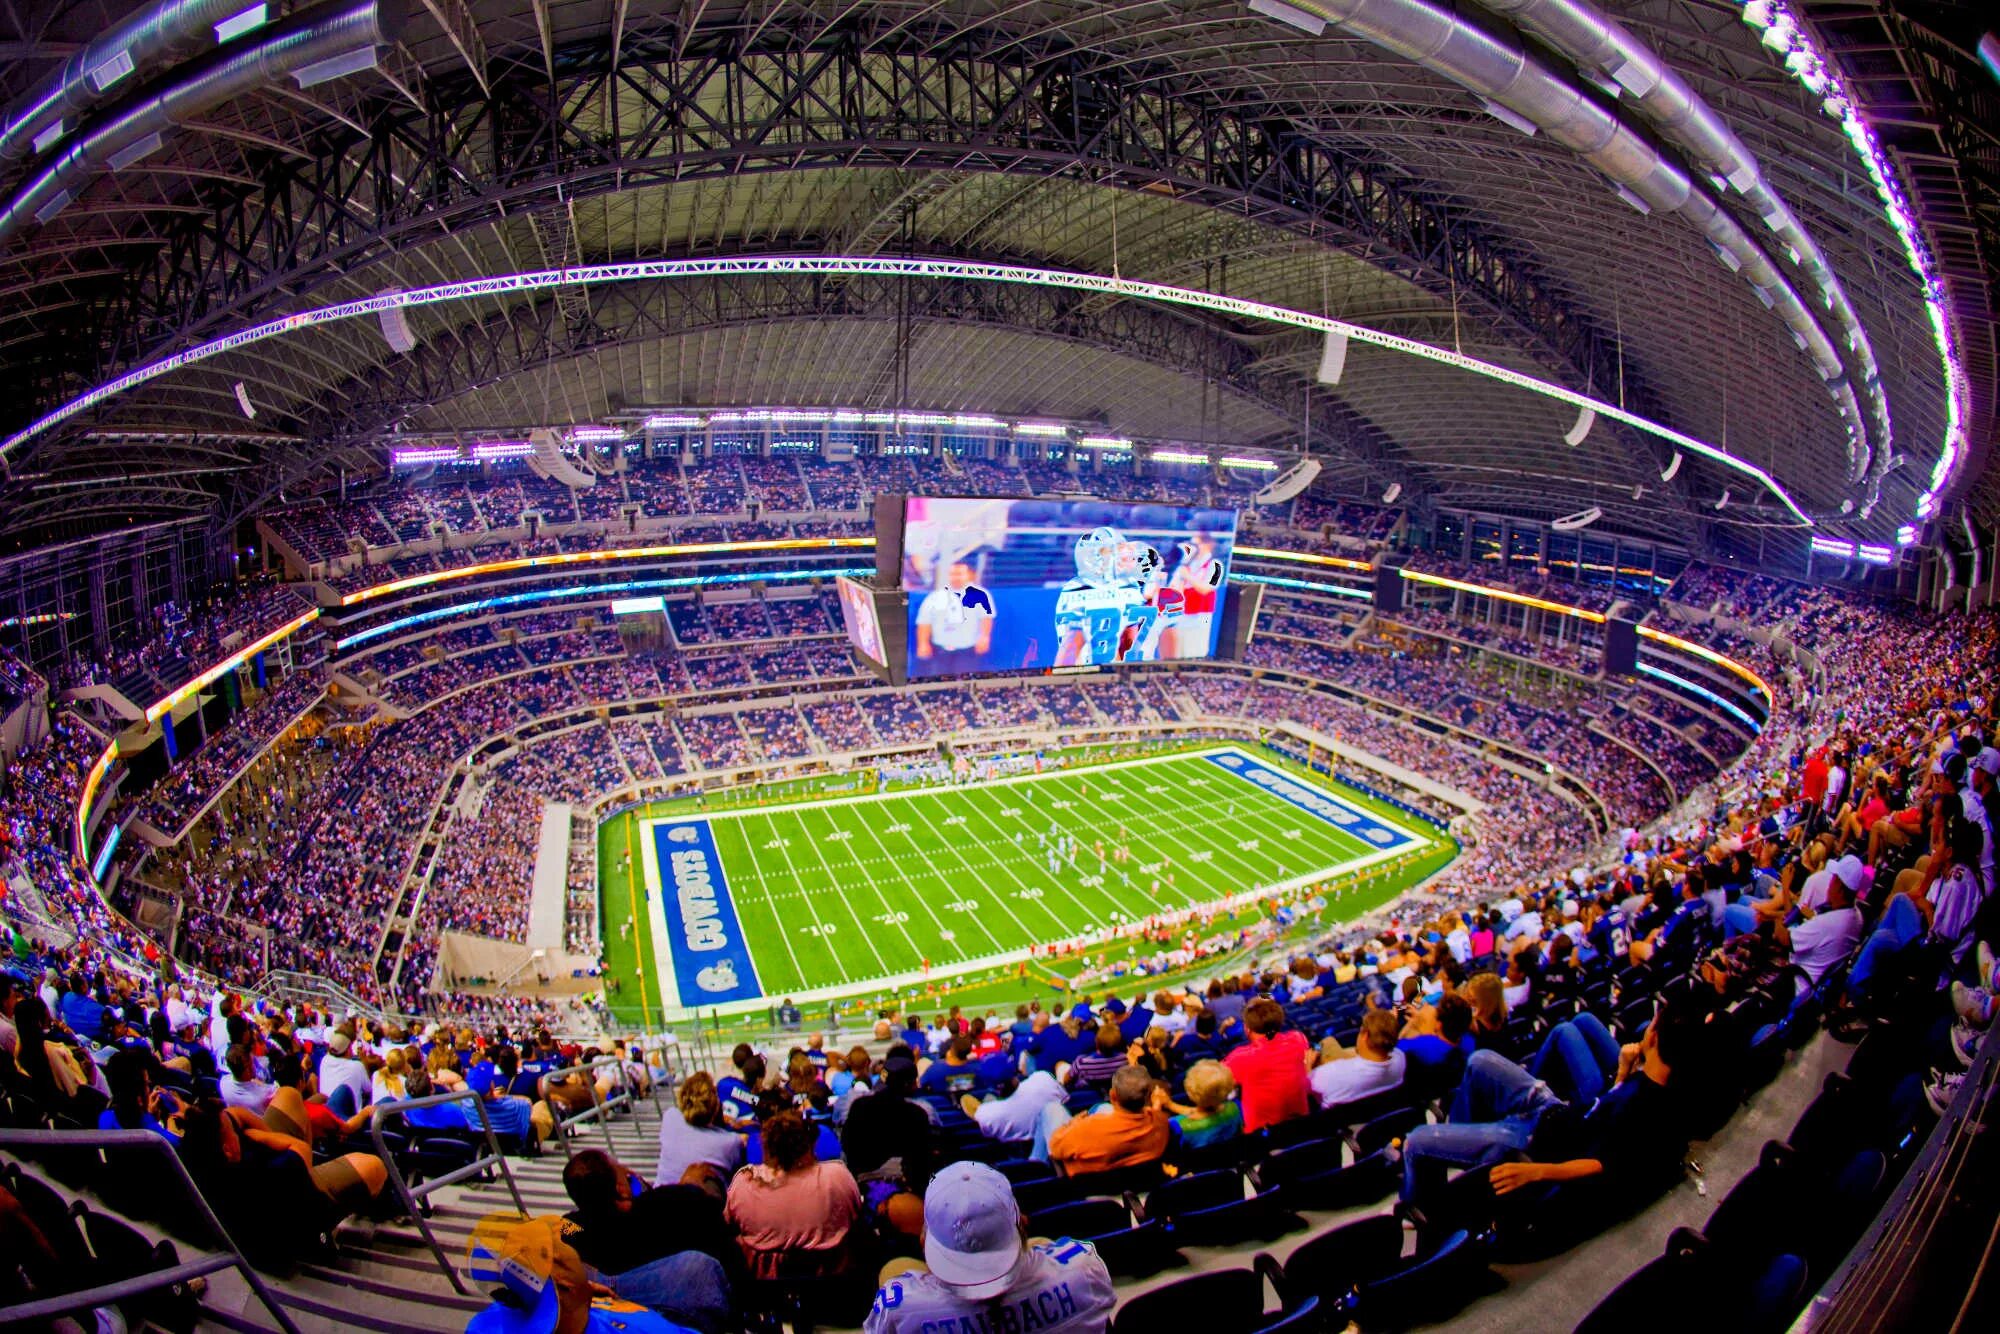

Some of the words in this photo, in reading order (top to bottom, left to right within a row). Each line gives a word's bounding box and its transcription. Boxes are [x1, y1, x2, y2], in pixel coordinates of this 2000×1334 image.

[671, 849, 728, 952] COWBOYS
[881, 911, 909, 925] 20
[810, 923, 837, 937] 10
